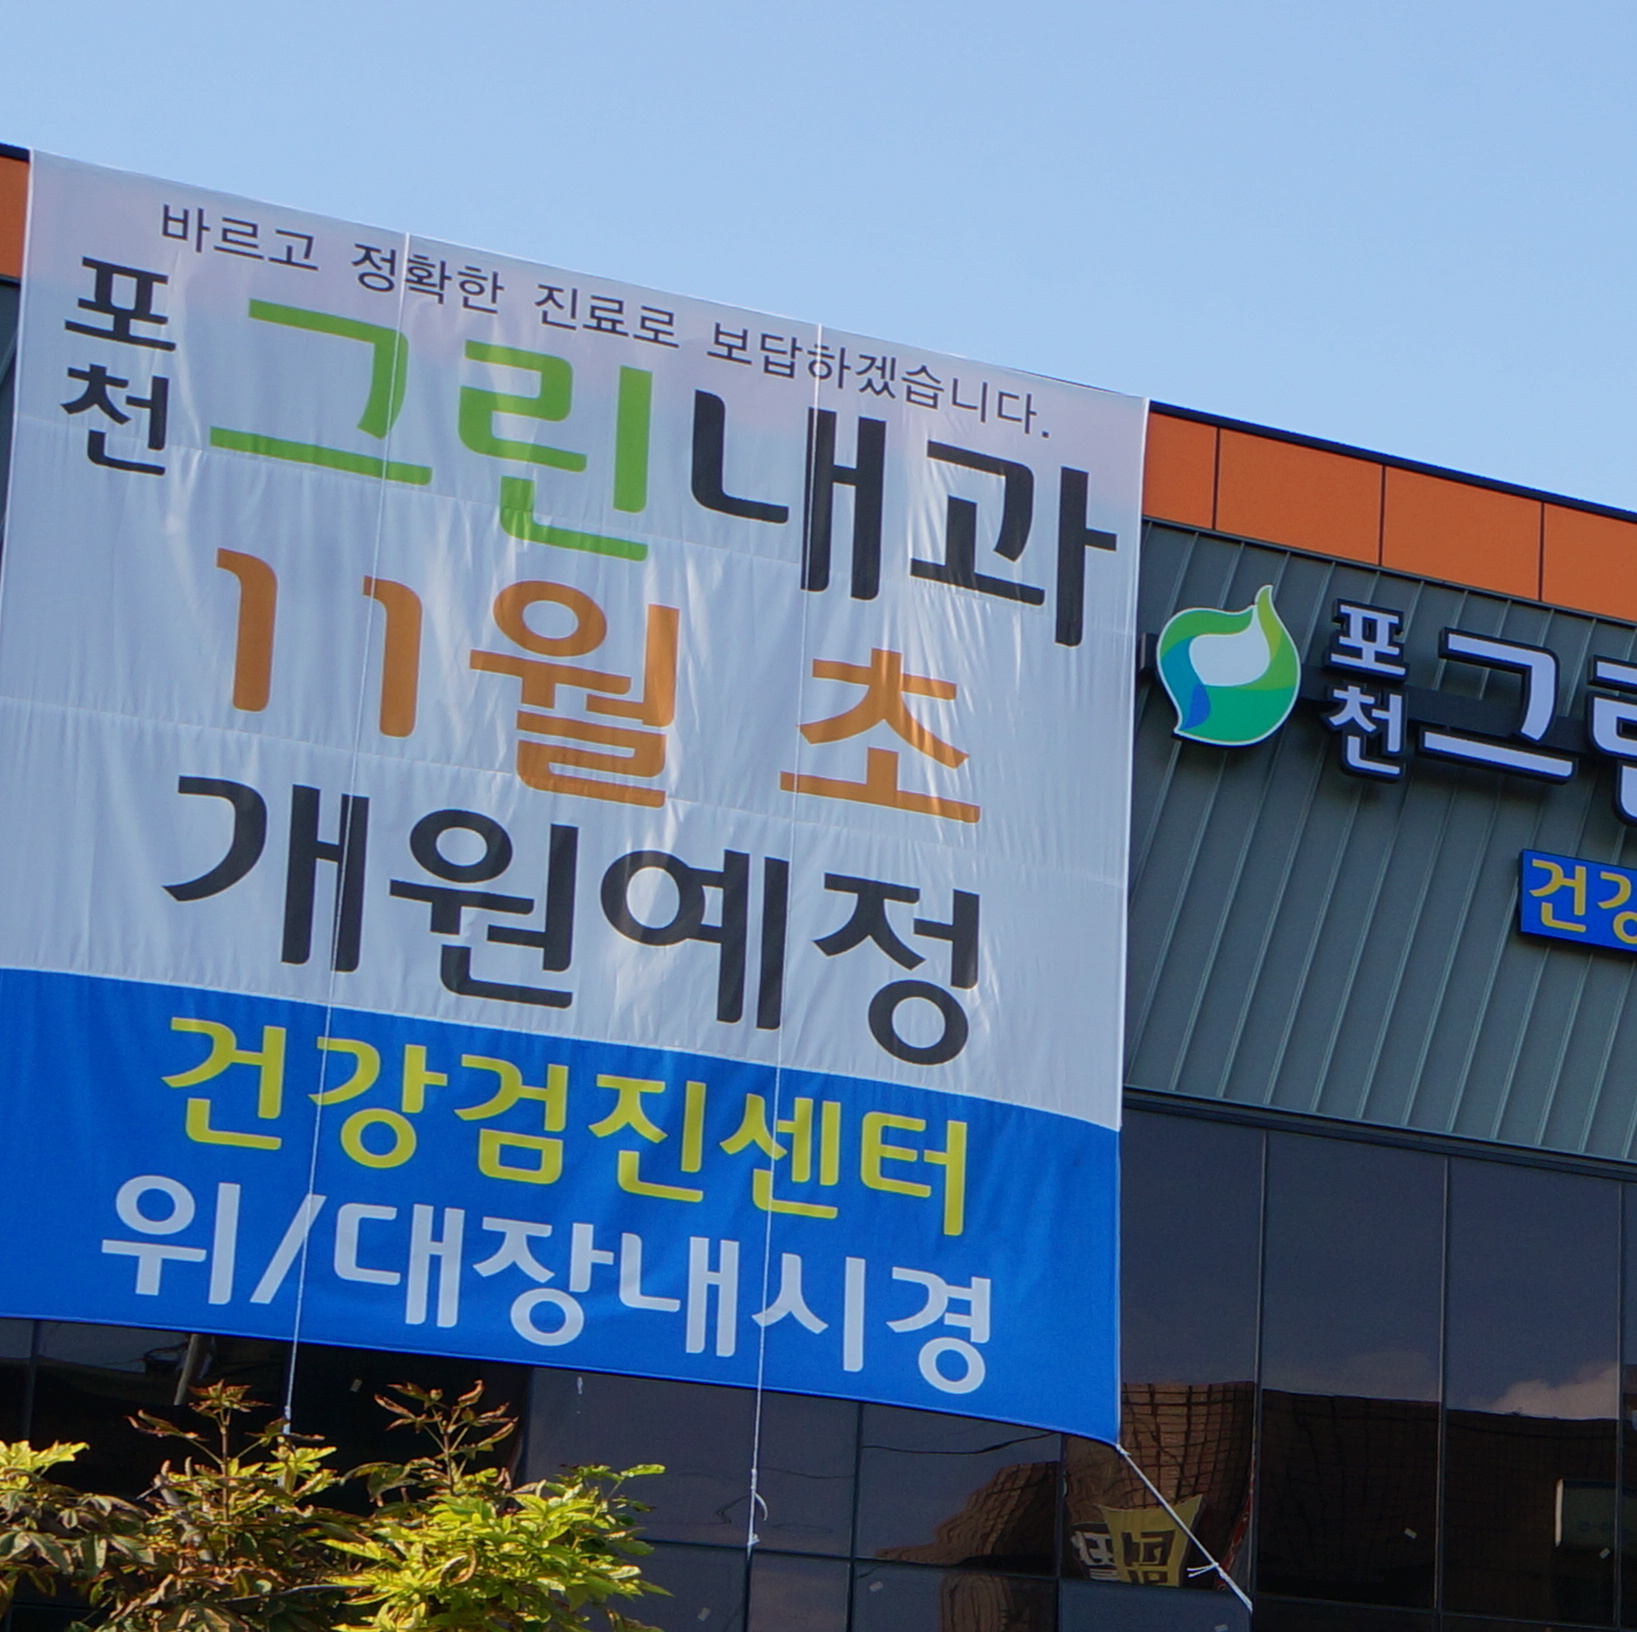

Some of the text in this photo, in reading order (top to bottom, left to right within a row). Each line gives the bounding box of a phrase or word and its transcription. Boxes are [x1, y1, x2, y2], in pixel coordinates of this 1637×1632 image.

[161, 203, 1052, 440] 바르고 정확한 진료로 보답하겠습니다.
[208, 297, 1118, 648] 그린내과
[216, 547, 981, 824] 11월 초
[161, 774, 982, 1067] 개원예정
[161, 1015, 969, 1237] 건강검진센터
[100, 1174, 994, 1396] 위/대장내시경
